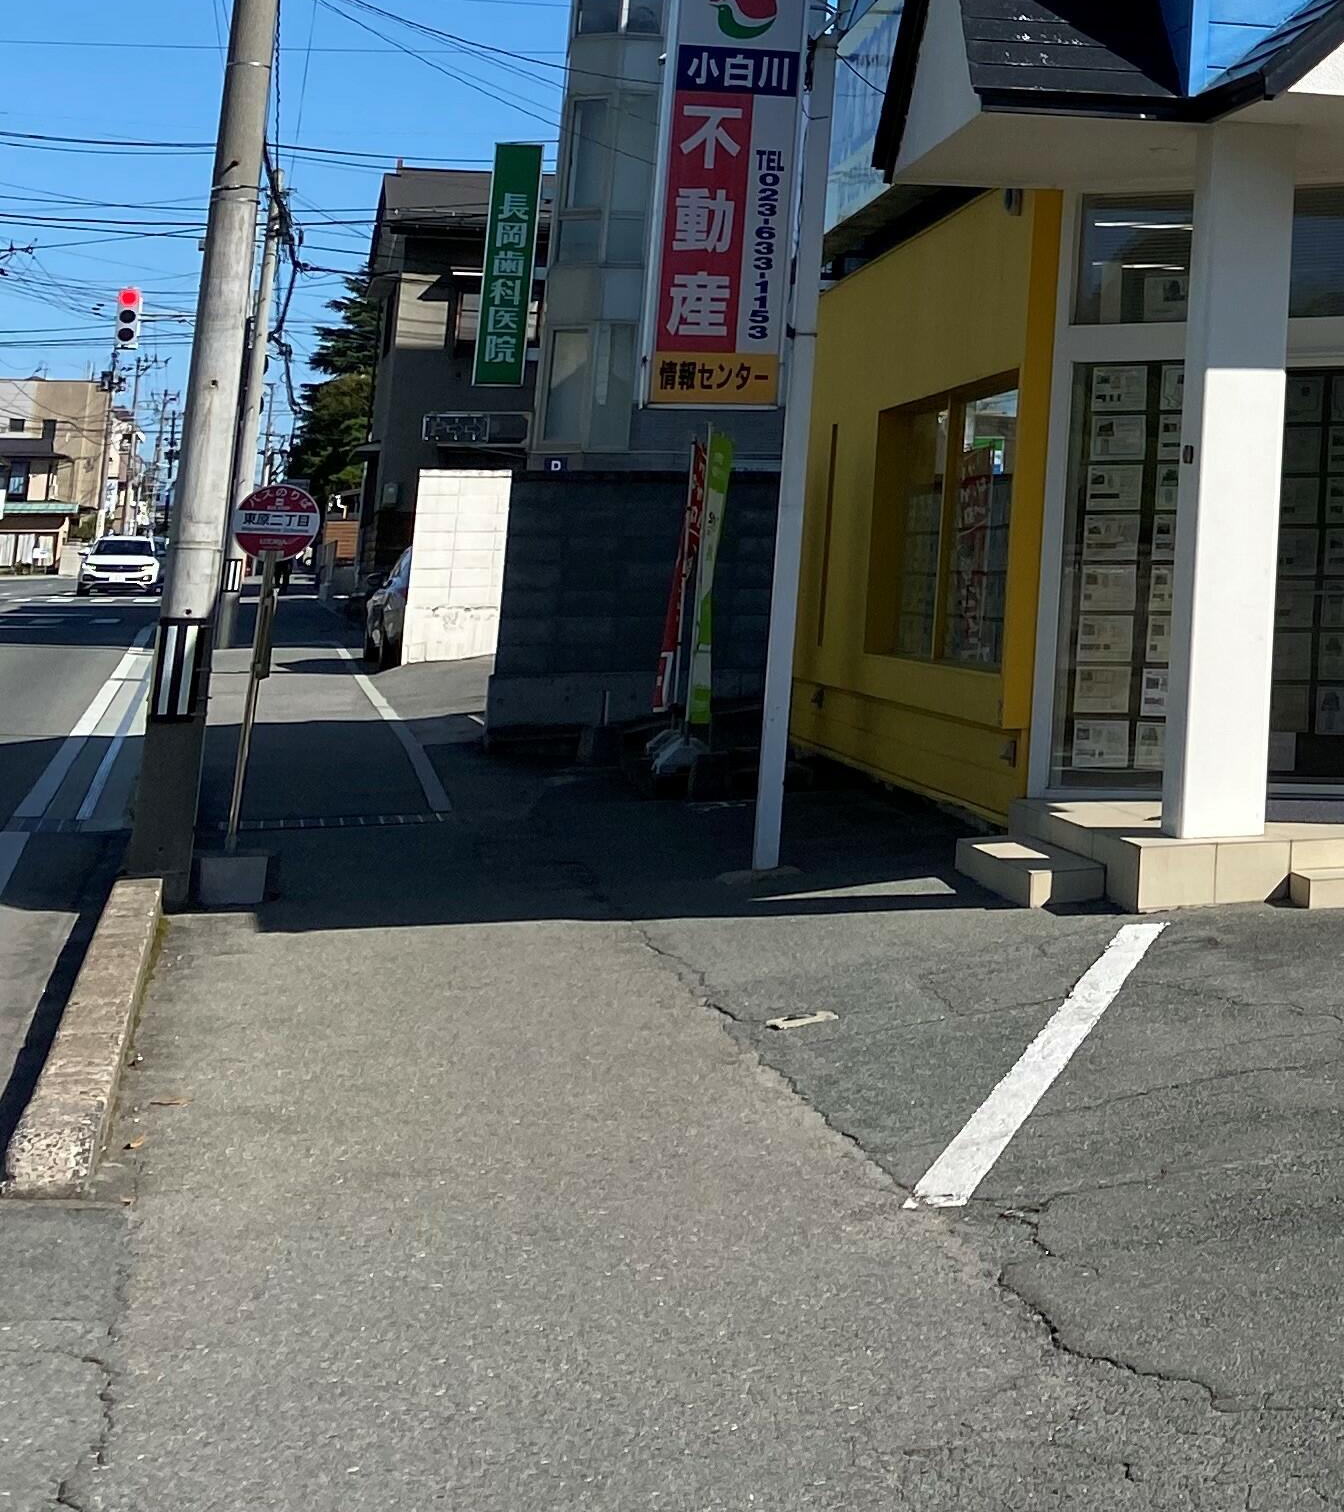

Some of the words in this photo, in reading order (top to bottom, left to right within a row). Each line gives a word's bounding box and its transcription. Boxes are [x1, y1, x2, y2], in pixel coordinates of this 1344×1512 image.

[687, 51, 791, 91] 小白川
[756, 149, 785, 172] TEL
[666, 104, 744, 338] 不動産
[748, 172, 781, 340] 023-633-1153
[484, 191, 530, 365] 長岡歯科医院
[659, 359, 769, 391] 情報センター
[248, 487, 313, 509] バスのりば
[242, 512, 310, 527] 東原二丁目
